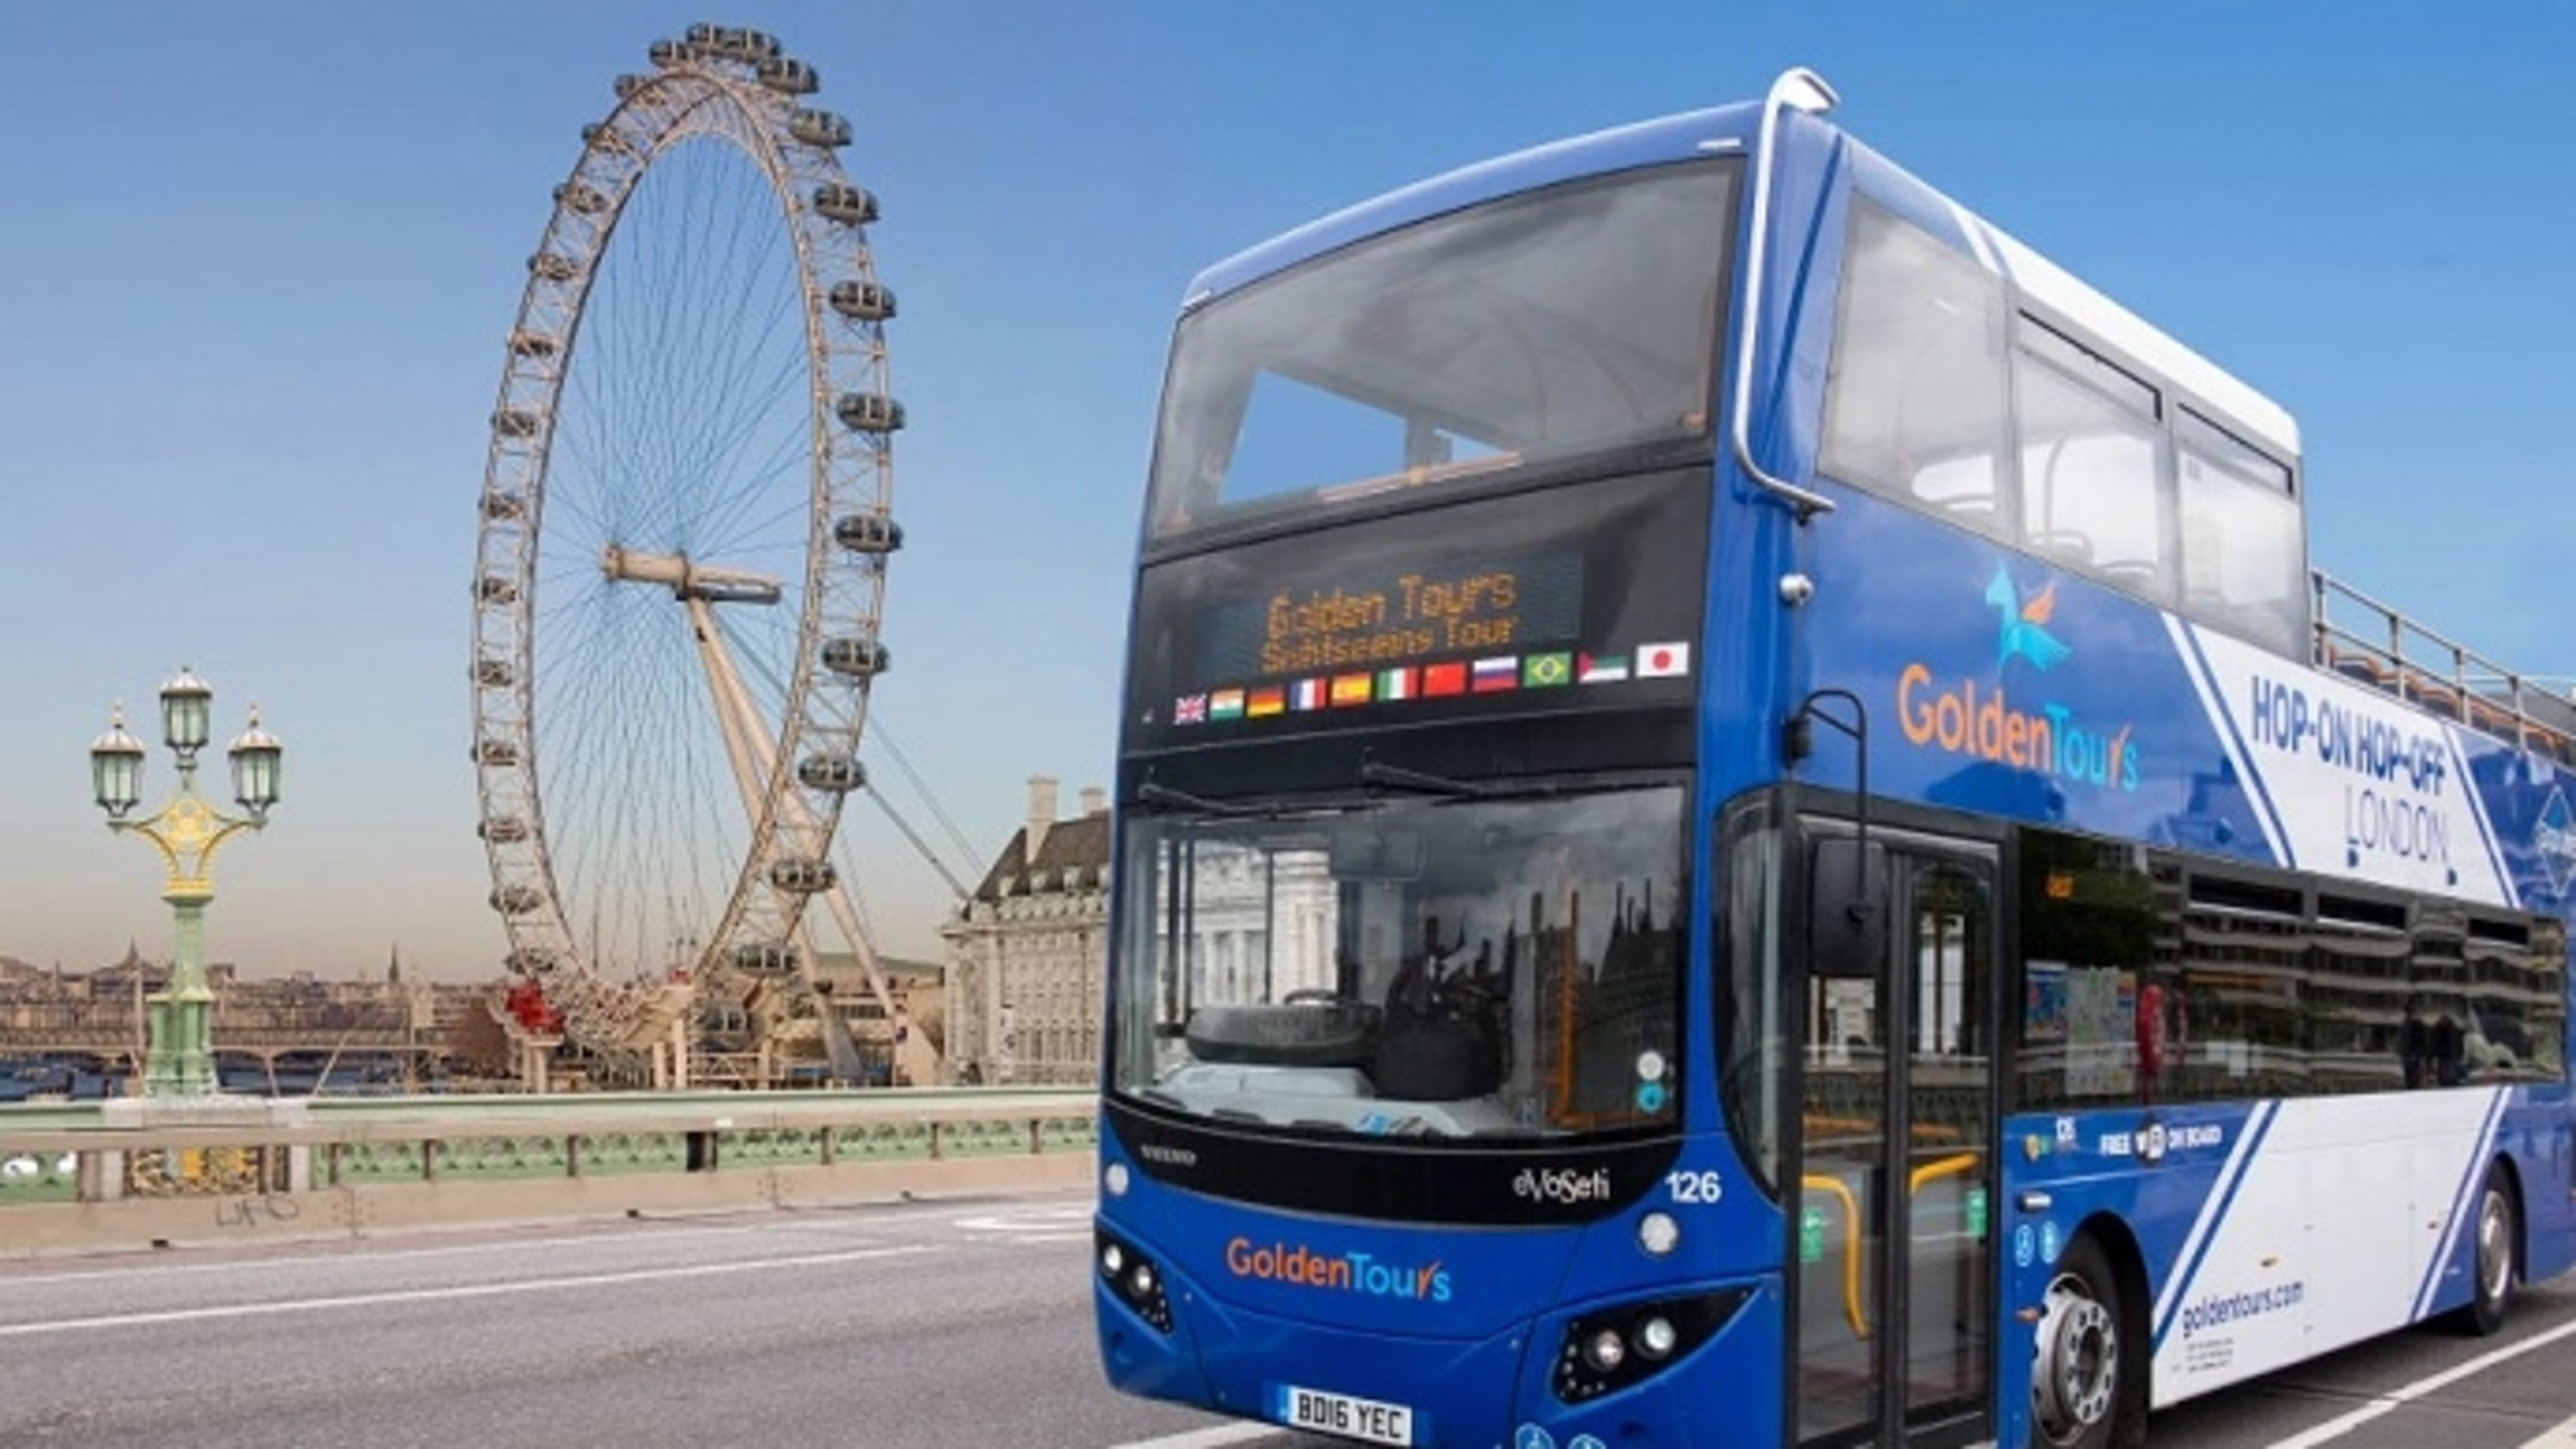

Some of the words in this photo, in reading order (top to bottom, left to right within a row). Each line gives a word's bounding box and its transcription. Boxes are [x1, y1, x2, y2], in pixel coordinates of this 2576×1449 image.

[1398, 573, 1516, 620] Tours
[1897, 663, 2138, 793] GoldenTours
[2251, 674, 2352, 770] HOP-ON
[2355, 713, 2445, 796] HOP-OFF
[2346, 784, 2449, 862] LONDON
[1665, 1171, 1722, 1202] 126
[1227, 1238, 1452, 1301] GoldenTours
[2184, 1281, 2303, 1339] goldentours.com
[1298, 1393, 1348, 1428] BD16
[1355, 1403, 1401, 1439] YEC
